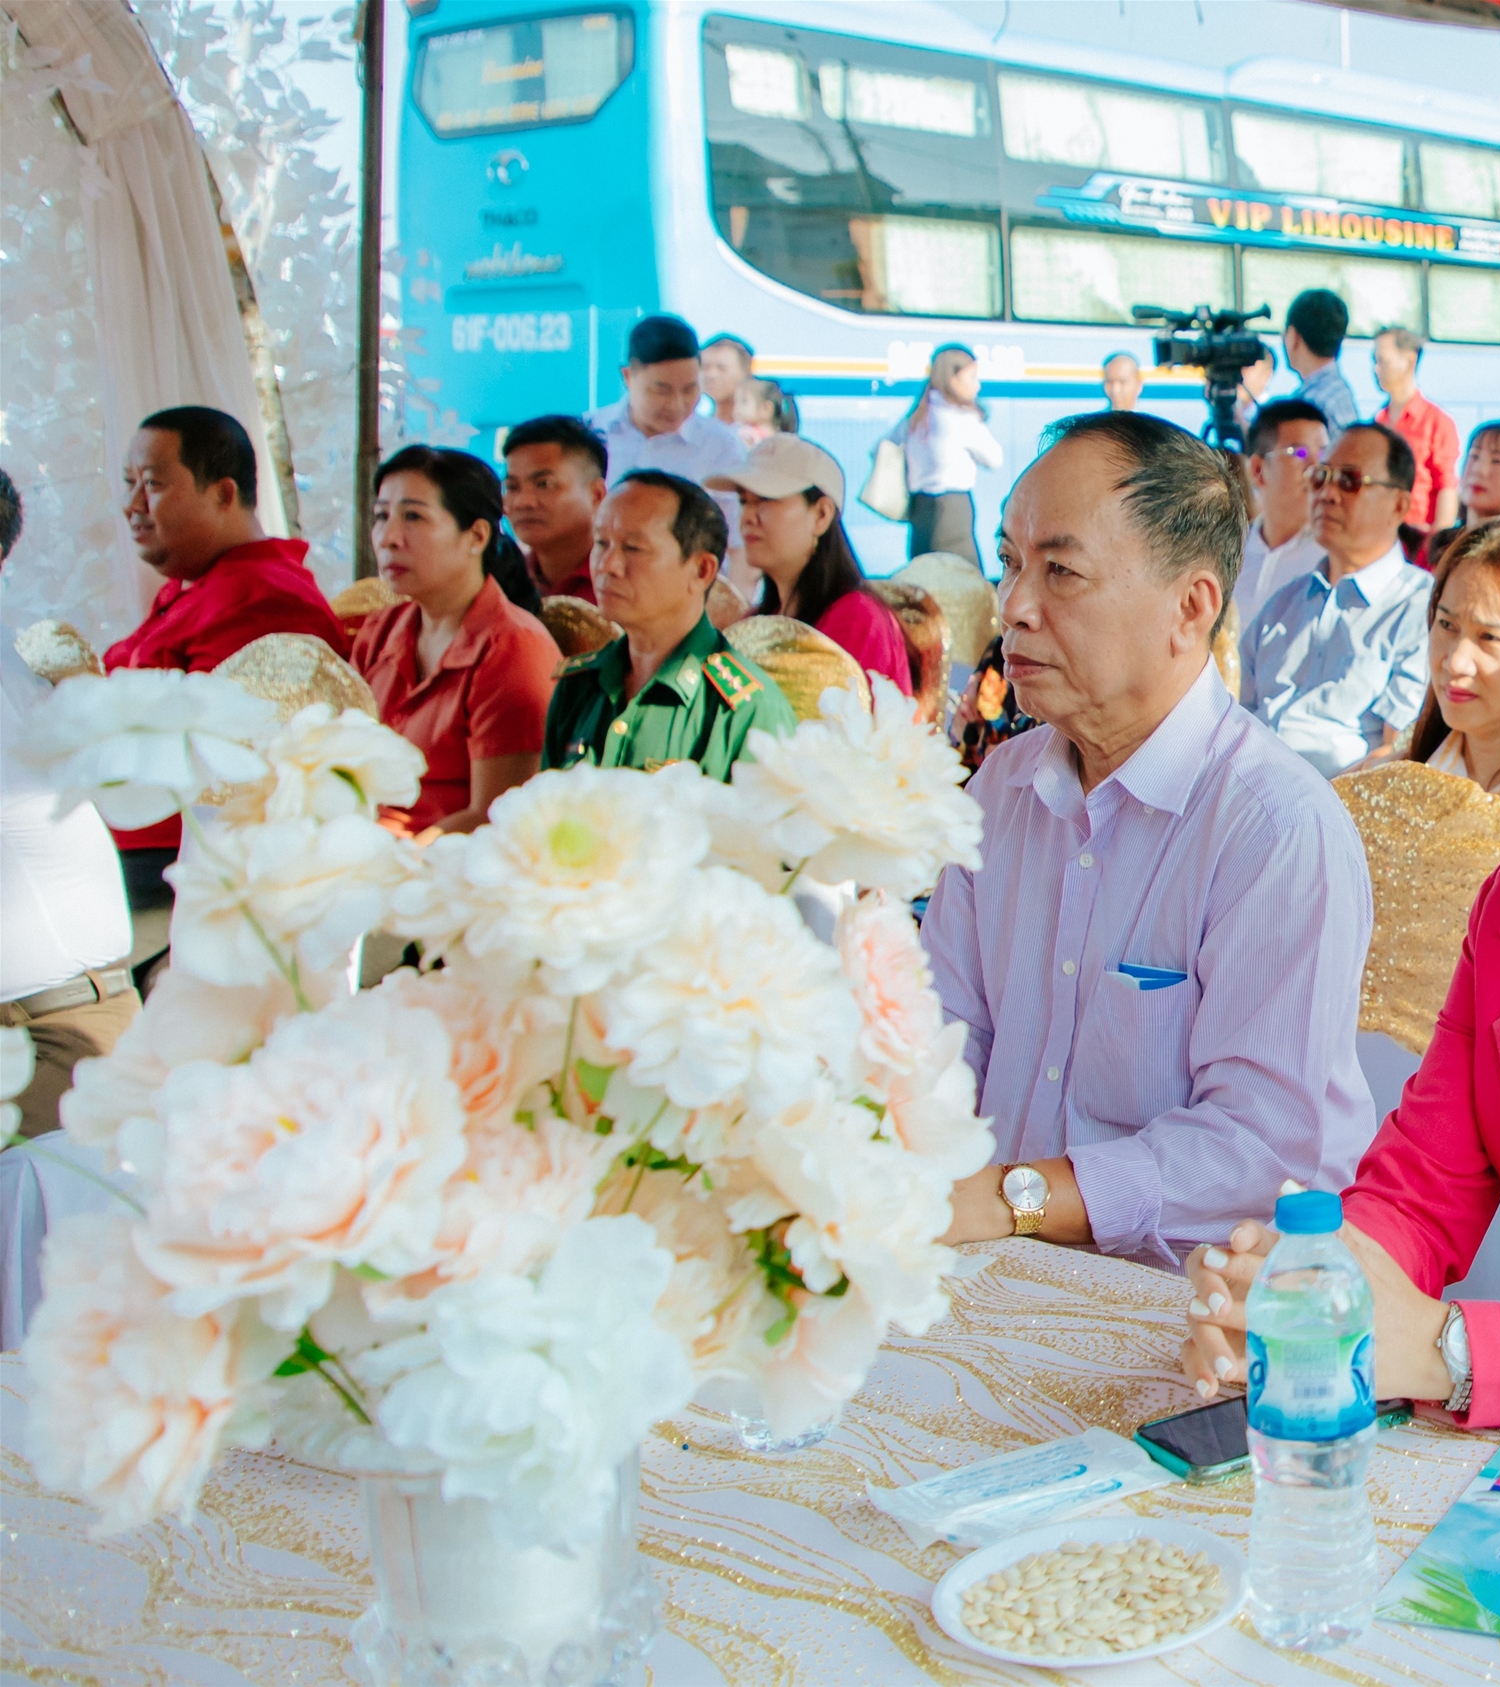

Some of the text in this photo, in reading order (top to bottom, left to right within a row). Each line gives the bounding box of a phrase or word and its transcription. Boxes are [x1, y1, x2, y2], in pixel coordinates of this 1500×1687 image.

[1207, 197, 1272, 232] VIP
[1280, 206, 1456, 251] LIMOUSINE
[452, 313, 571, 352] 61F-006.23
